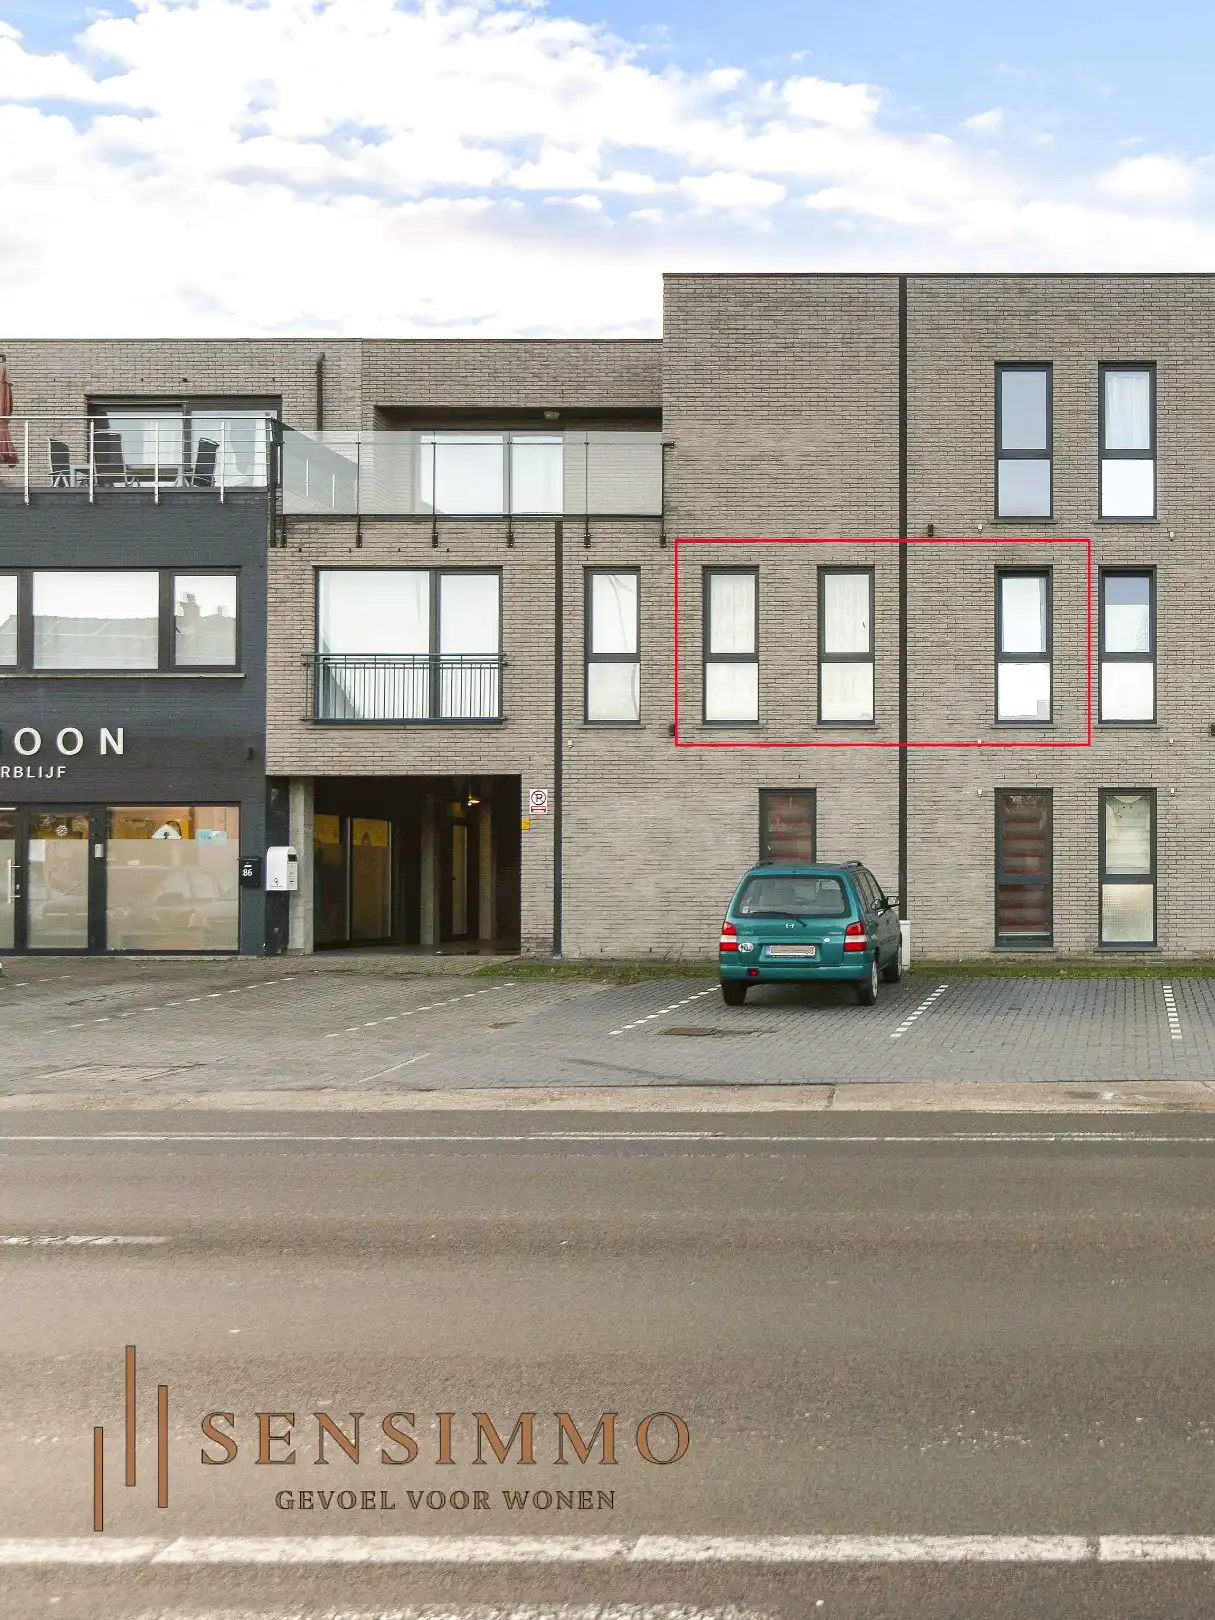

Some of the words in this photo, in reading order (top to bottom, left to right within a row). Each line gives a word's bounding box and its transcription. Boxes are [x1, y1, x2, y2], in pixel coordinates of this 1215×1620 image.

[14, 727, 124, 756] OON
[1, 765, 66, 779] RBLIJF
[242, 868, 253, 876] 86
